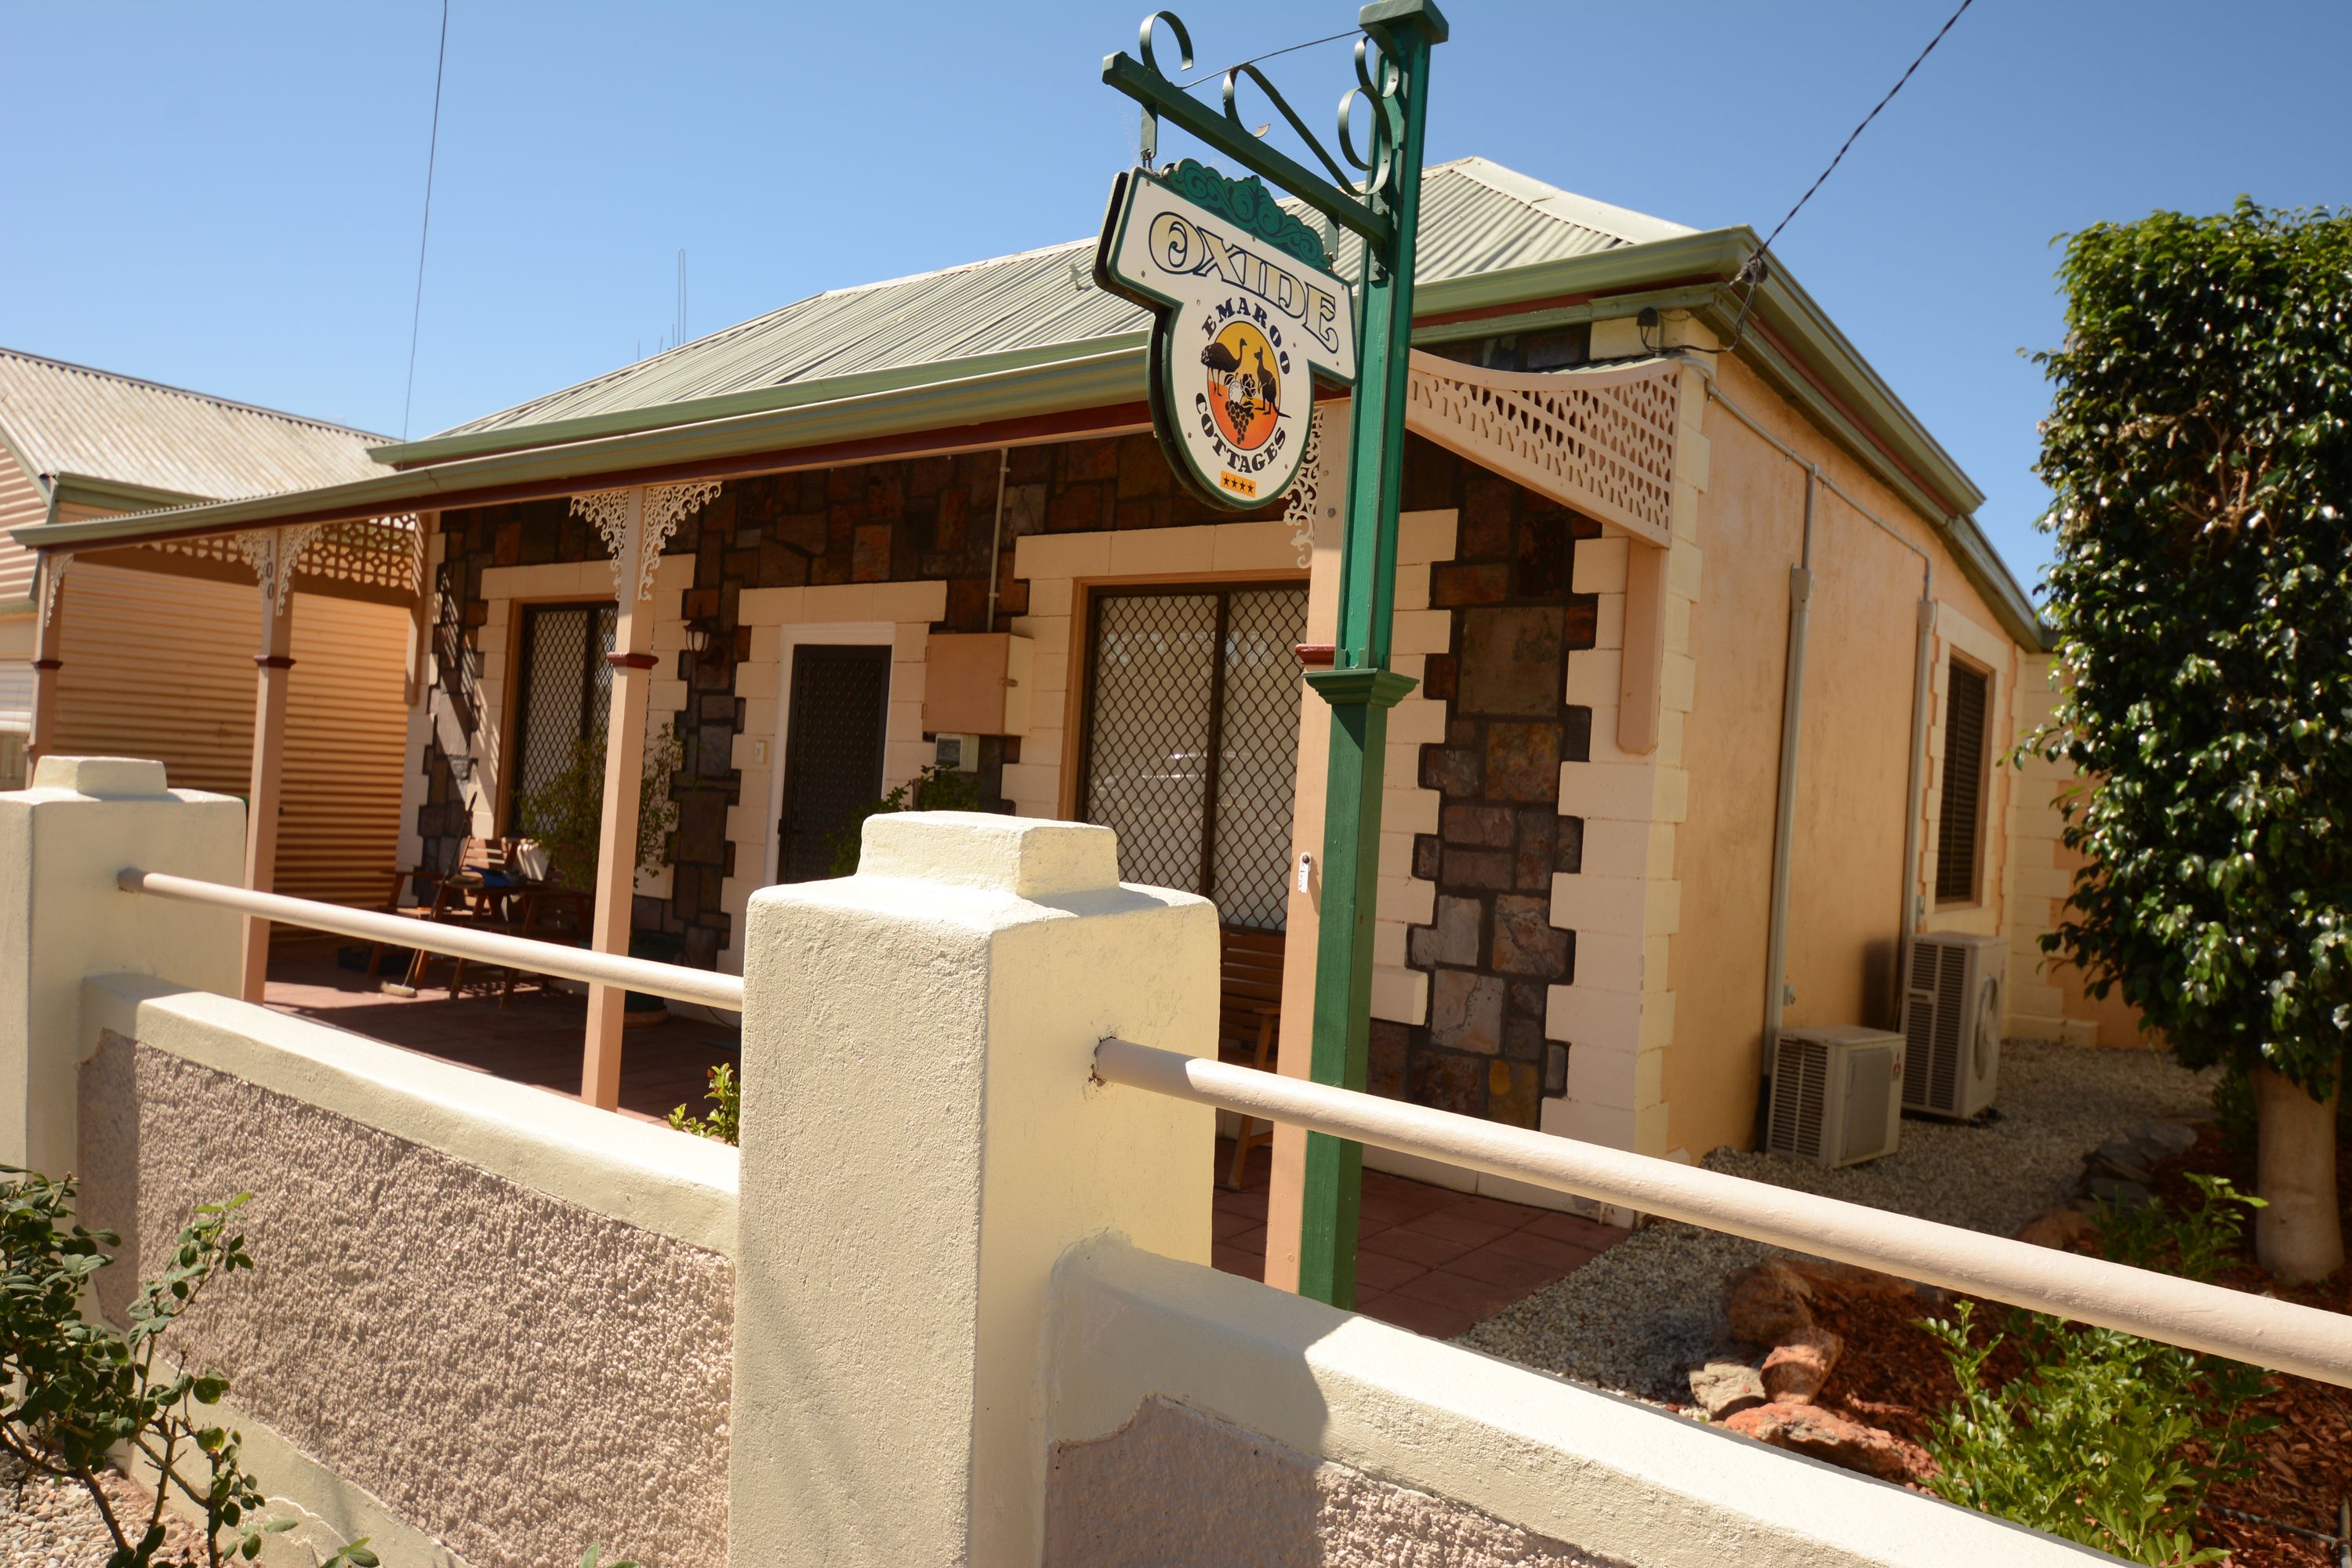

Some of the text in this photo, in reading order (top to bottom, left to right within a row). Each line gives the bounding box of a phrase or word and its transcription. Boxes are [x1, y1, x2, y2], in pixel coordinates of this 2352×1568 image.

[1148, 211, 1340, 354] OXIDE
[1201, 296, 1290, 376] EMAROO
[1195, 391, 1287, 474] COTTAGES
